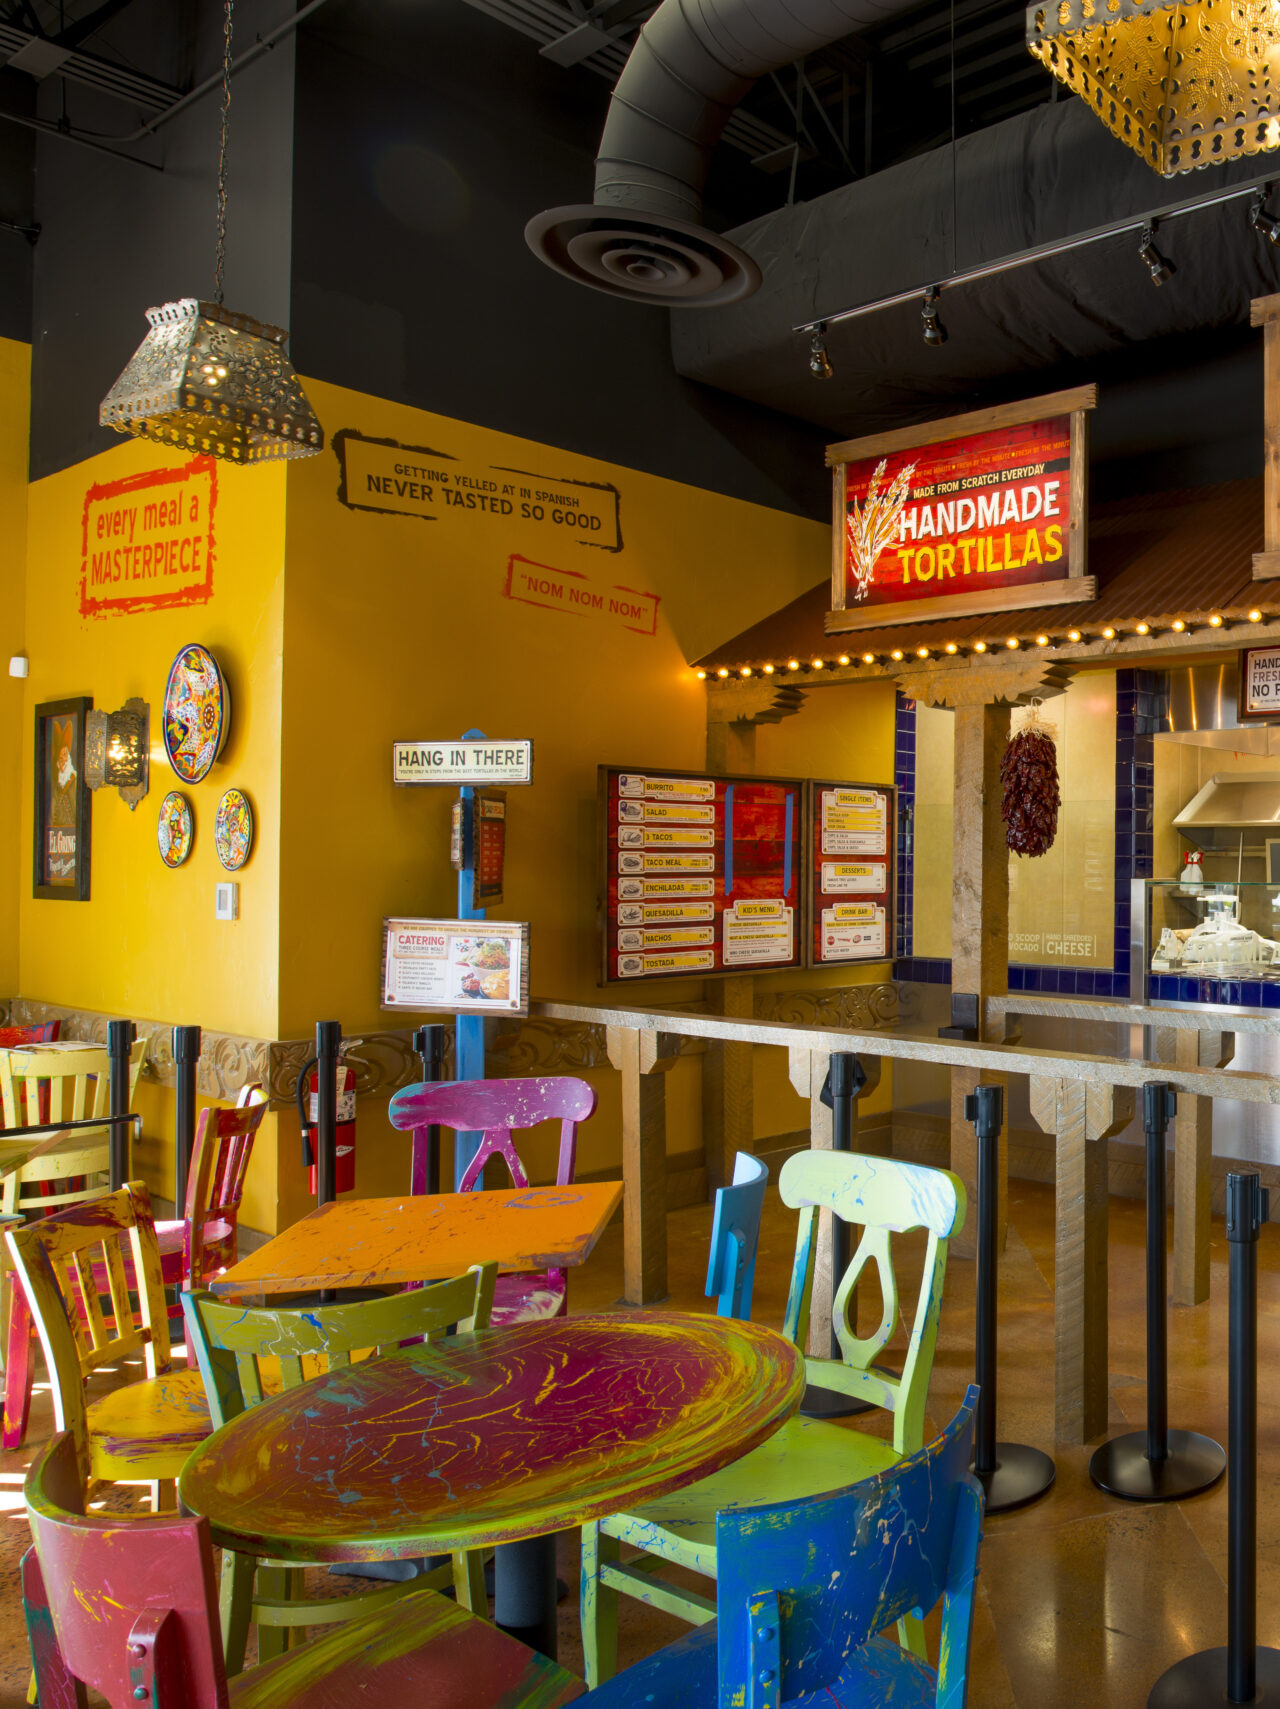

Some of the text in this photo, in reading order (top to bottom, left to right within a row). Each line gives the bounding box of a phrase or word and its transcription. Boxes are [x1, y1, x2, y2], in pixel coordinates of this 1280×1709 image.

[394, 463, 579, 508] GETTING YELLED AT IN SPANISH
[913, 464, 1045, 499] MADE FROM SCRATCH EVERYDAY
[367, 474, 601, 531] NEVER TASTED SO GOOD
[900, 480, 1060, 542] HANDMADE
[96, 488, 199, 544] every meal a
[91, 535, 202, 586] MASTERPIECE
[897, 524, 1063, 584] TORTILLAS
[569, 588, 604, 610] NOM
[1252, 684, 1270, 697] NO
[398, 749, 525, 767] HANG IN THERE
[646, 884, 685, 892] ENCHILADAS
[398, 935, 445, 946] CATERING
[1016, 934, 1040, 942] SCOOP
[1046, 941, 1092, 957] CHEESE
[646, 960, 675, 968] TOSTADA
